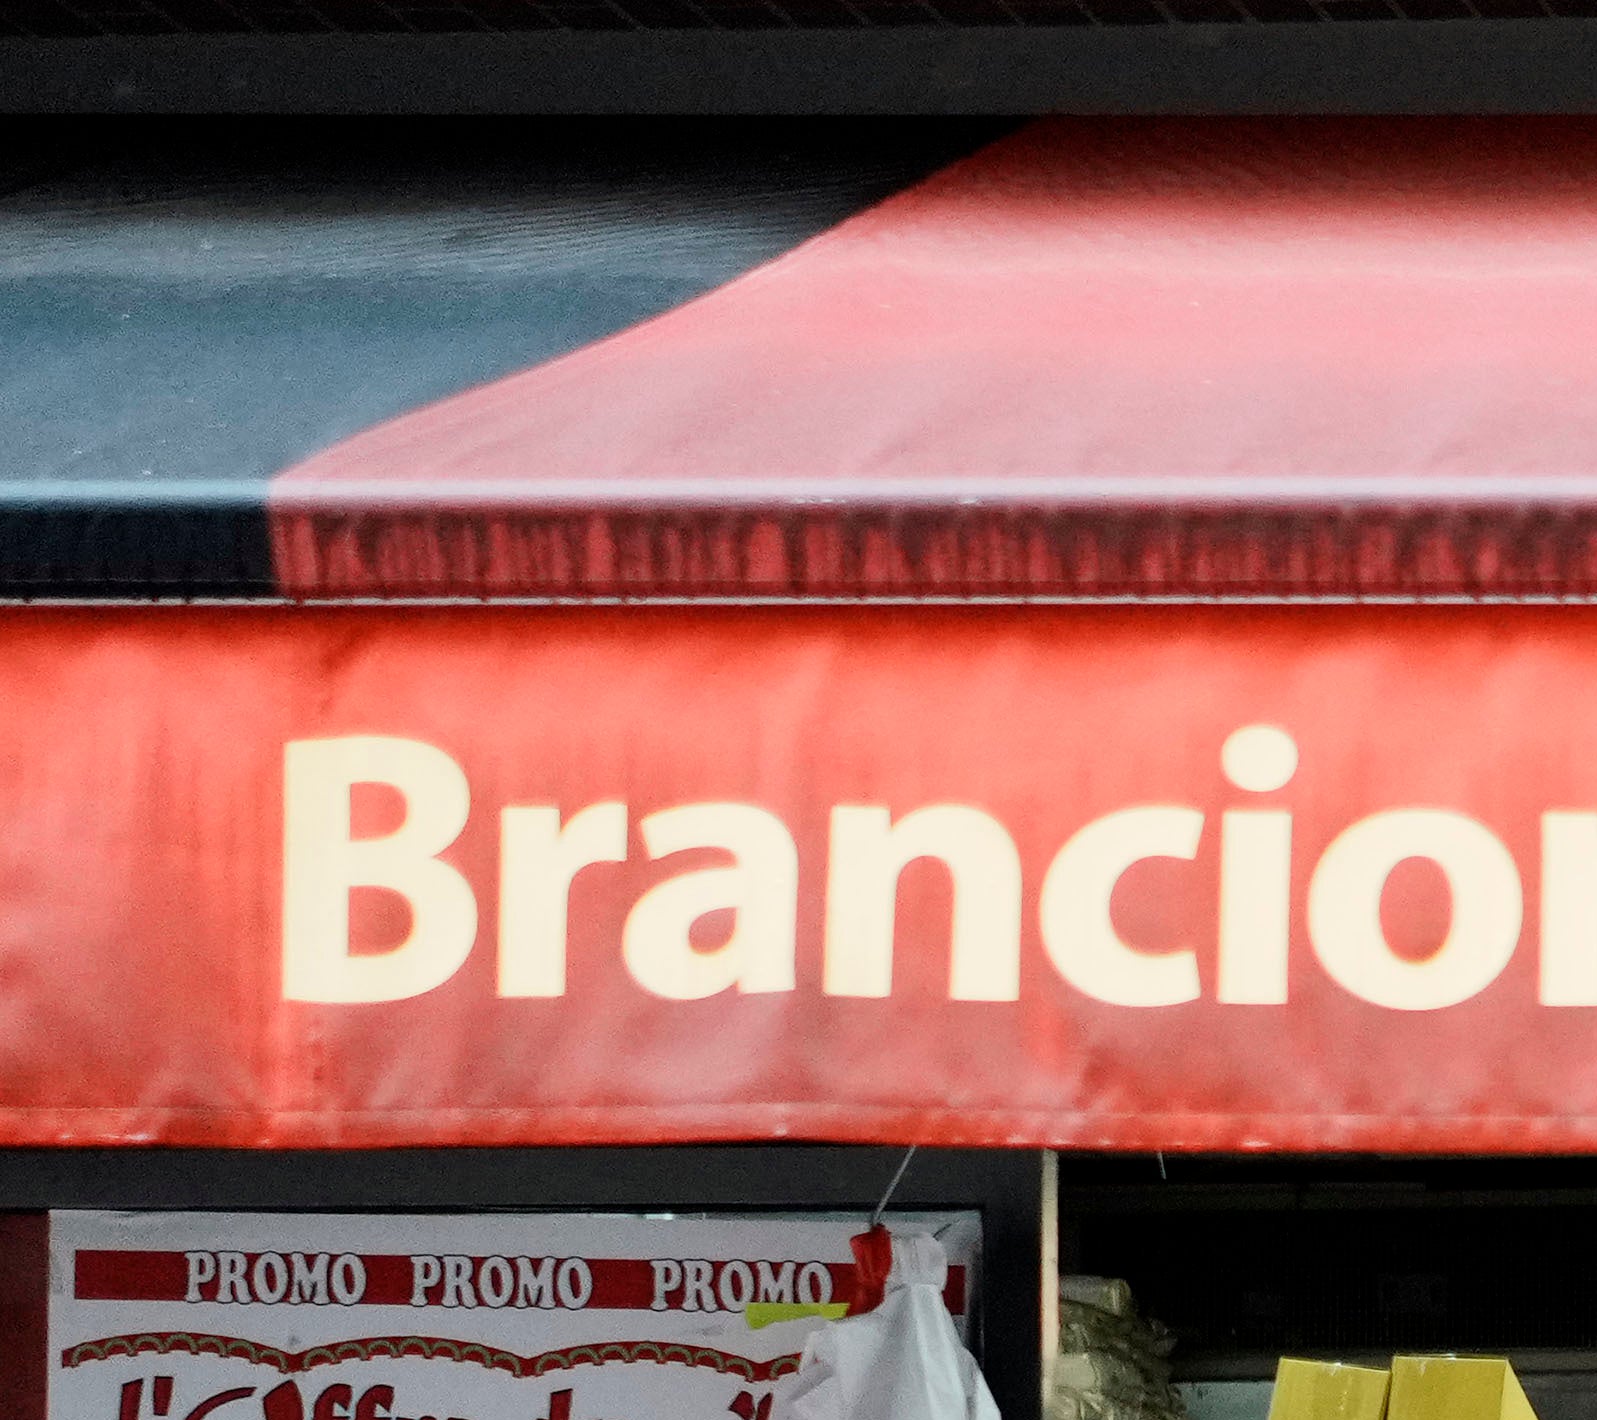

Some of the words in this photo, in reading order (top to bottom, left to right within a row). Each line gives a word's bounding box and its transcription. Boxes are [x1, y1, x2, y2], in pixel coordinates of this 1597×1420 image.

[185, 1250, 368, 1306] PROMO
[410, 1255, 592, 1310] PROMO
[651, 1258, 834, 1314] PROMO
